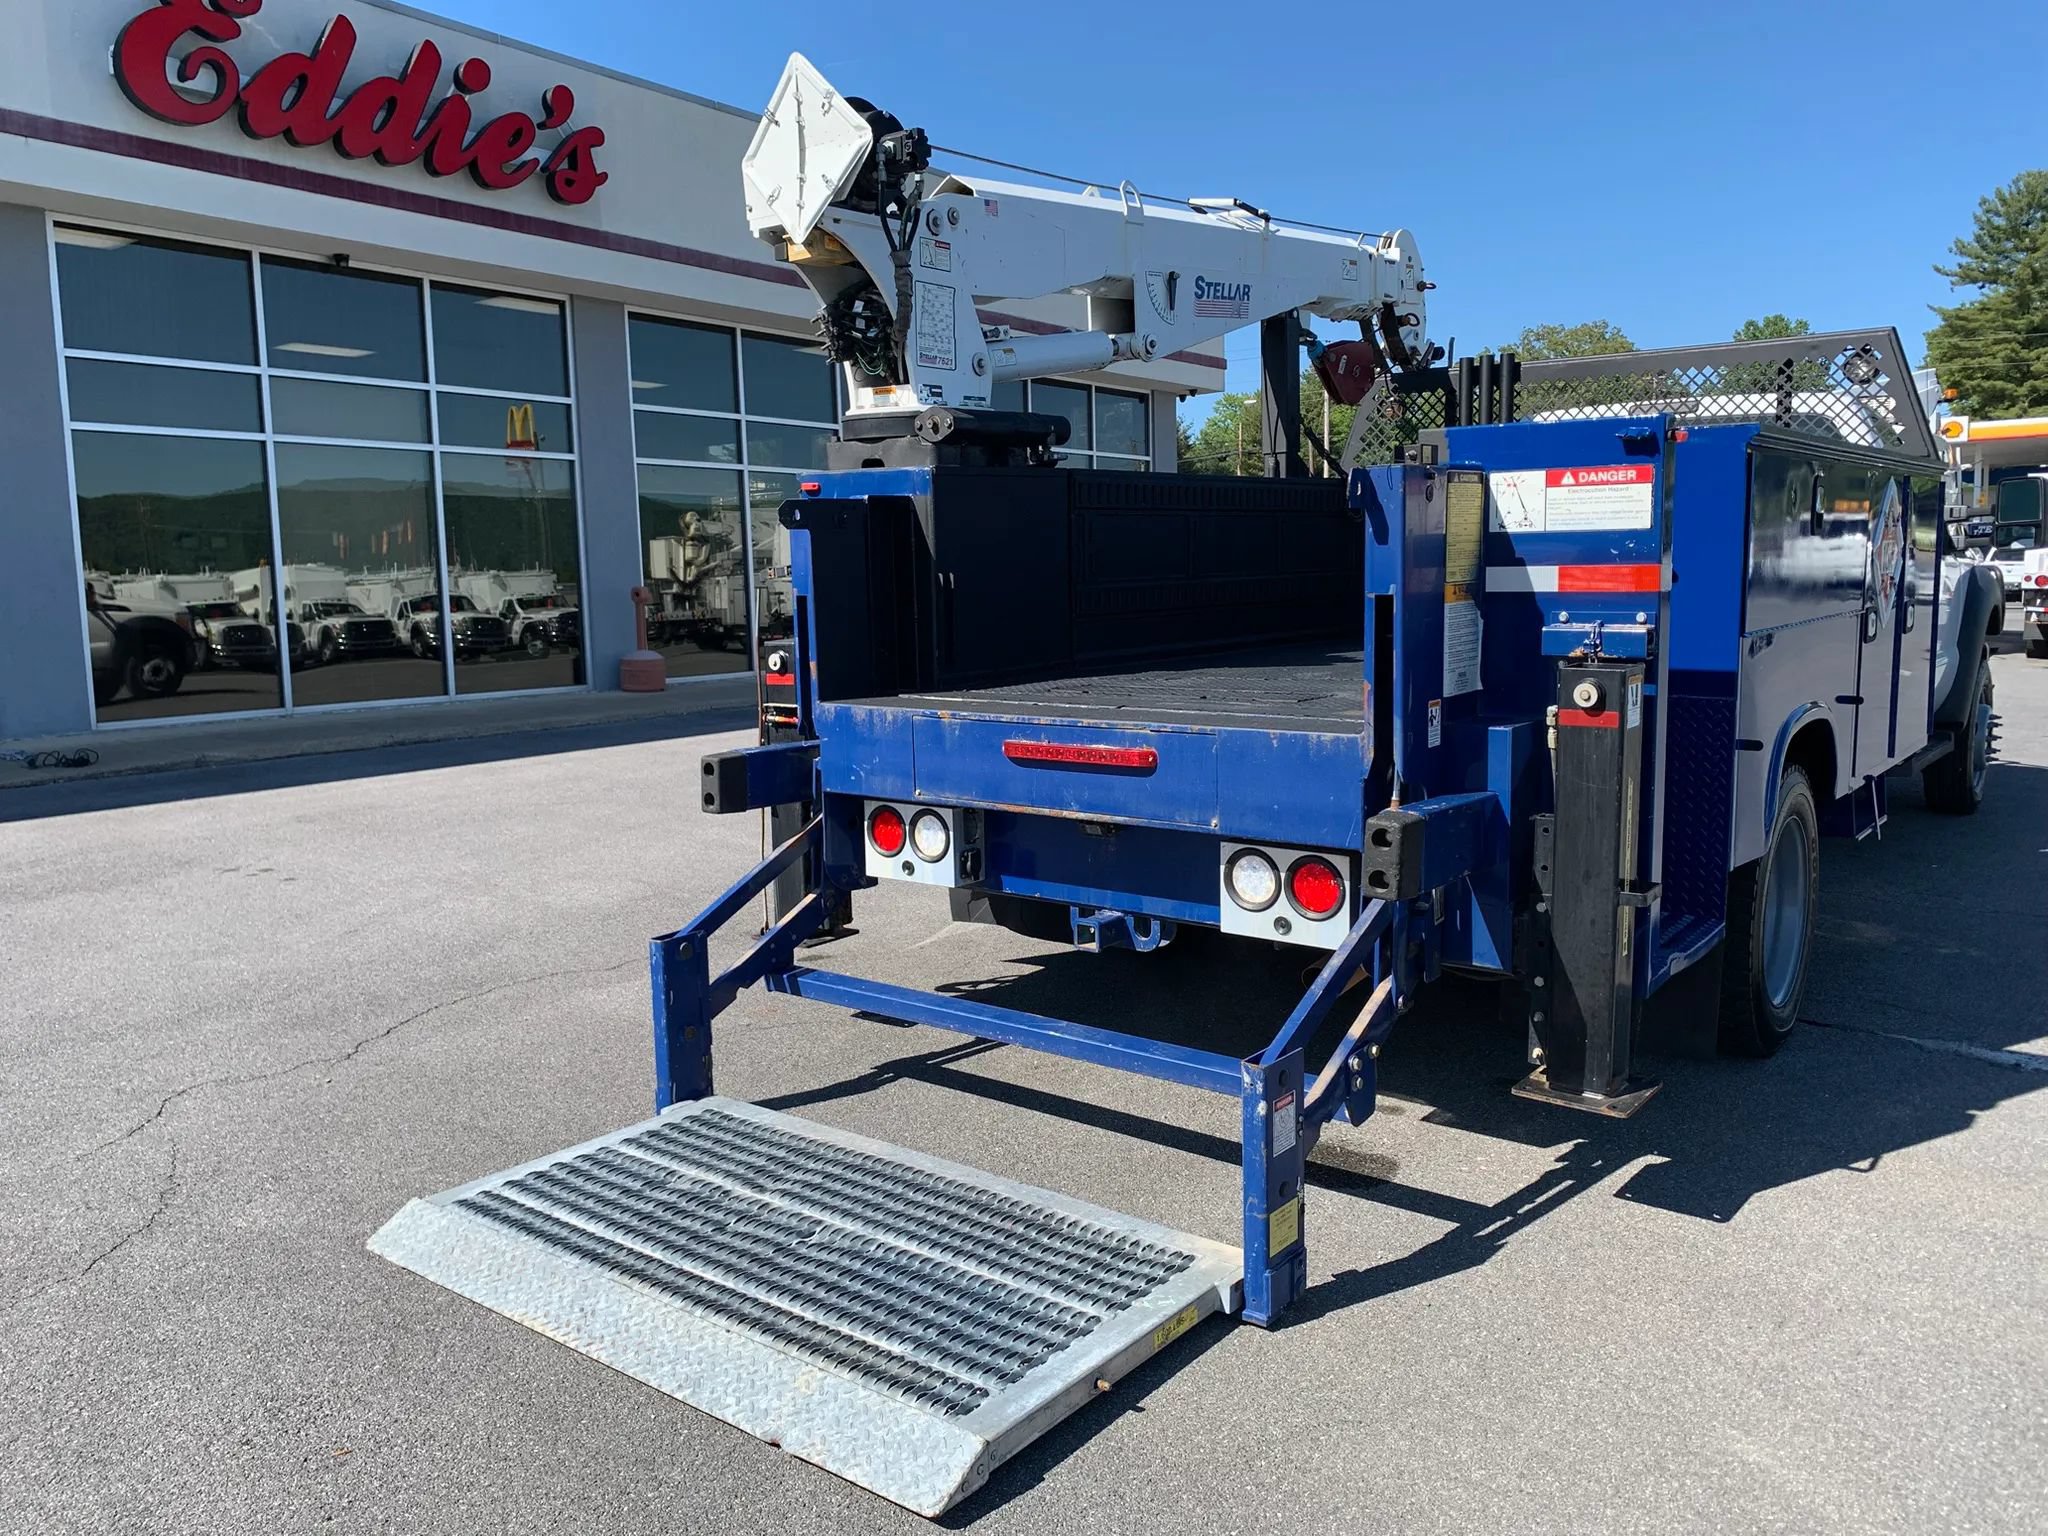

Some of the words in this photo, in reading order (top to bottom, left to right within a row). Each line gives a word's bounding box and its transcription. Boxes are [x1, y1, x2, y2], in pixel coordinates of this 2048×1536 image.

[112, 0, 608, 205] Eddie's
[1194, 275, 1251, 301] STELLAR
[1578, 469, 1637, 483] DANGER
[1567, 487, 1607, 495] Electrocution
[1607, 485, 1630, 493] Hazard
